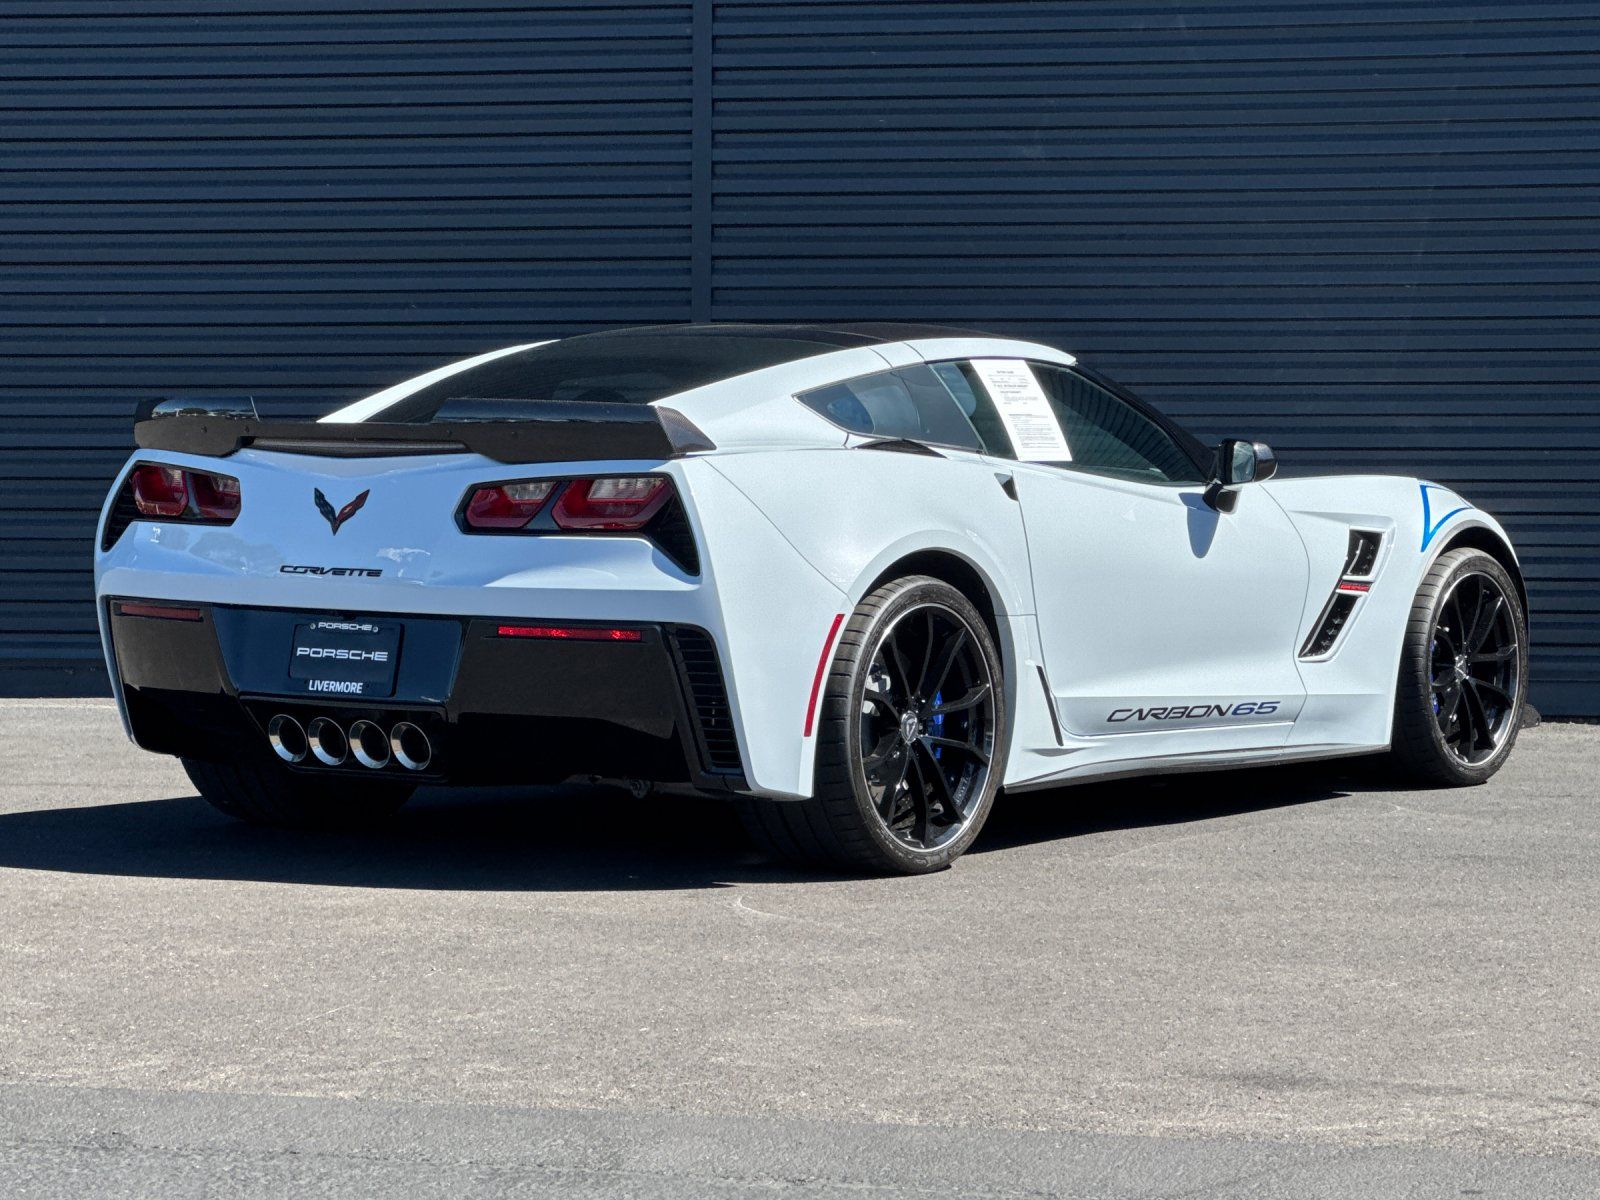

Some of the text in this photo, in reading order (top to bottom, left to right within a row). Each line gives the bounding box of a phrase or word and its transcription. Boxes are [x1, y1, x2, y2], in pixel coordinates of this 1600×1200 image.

[280, 565, 383, 577] CORVETTE
[318, 622, 372, 631] PORSCHE
[296, 647, 388, 661] PORSCHE
[309, 680, 363, 693] LIVERMORE
